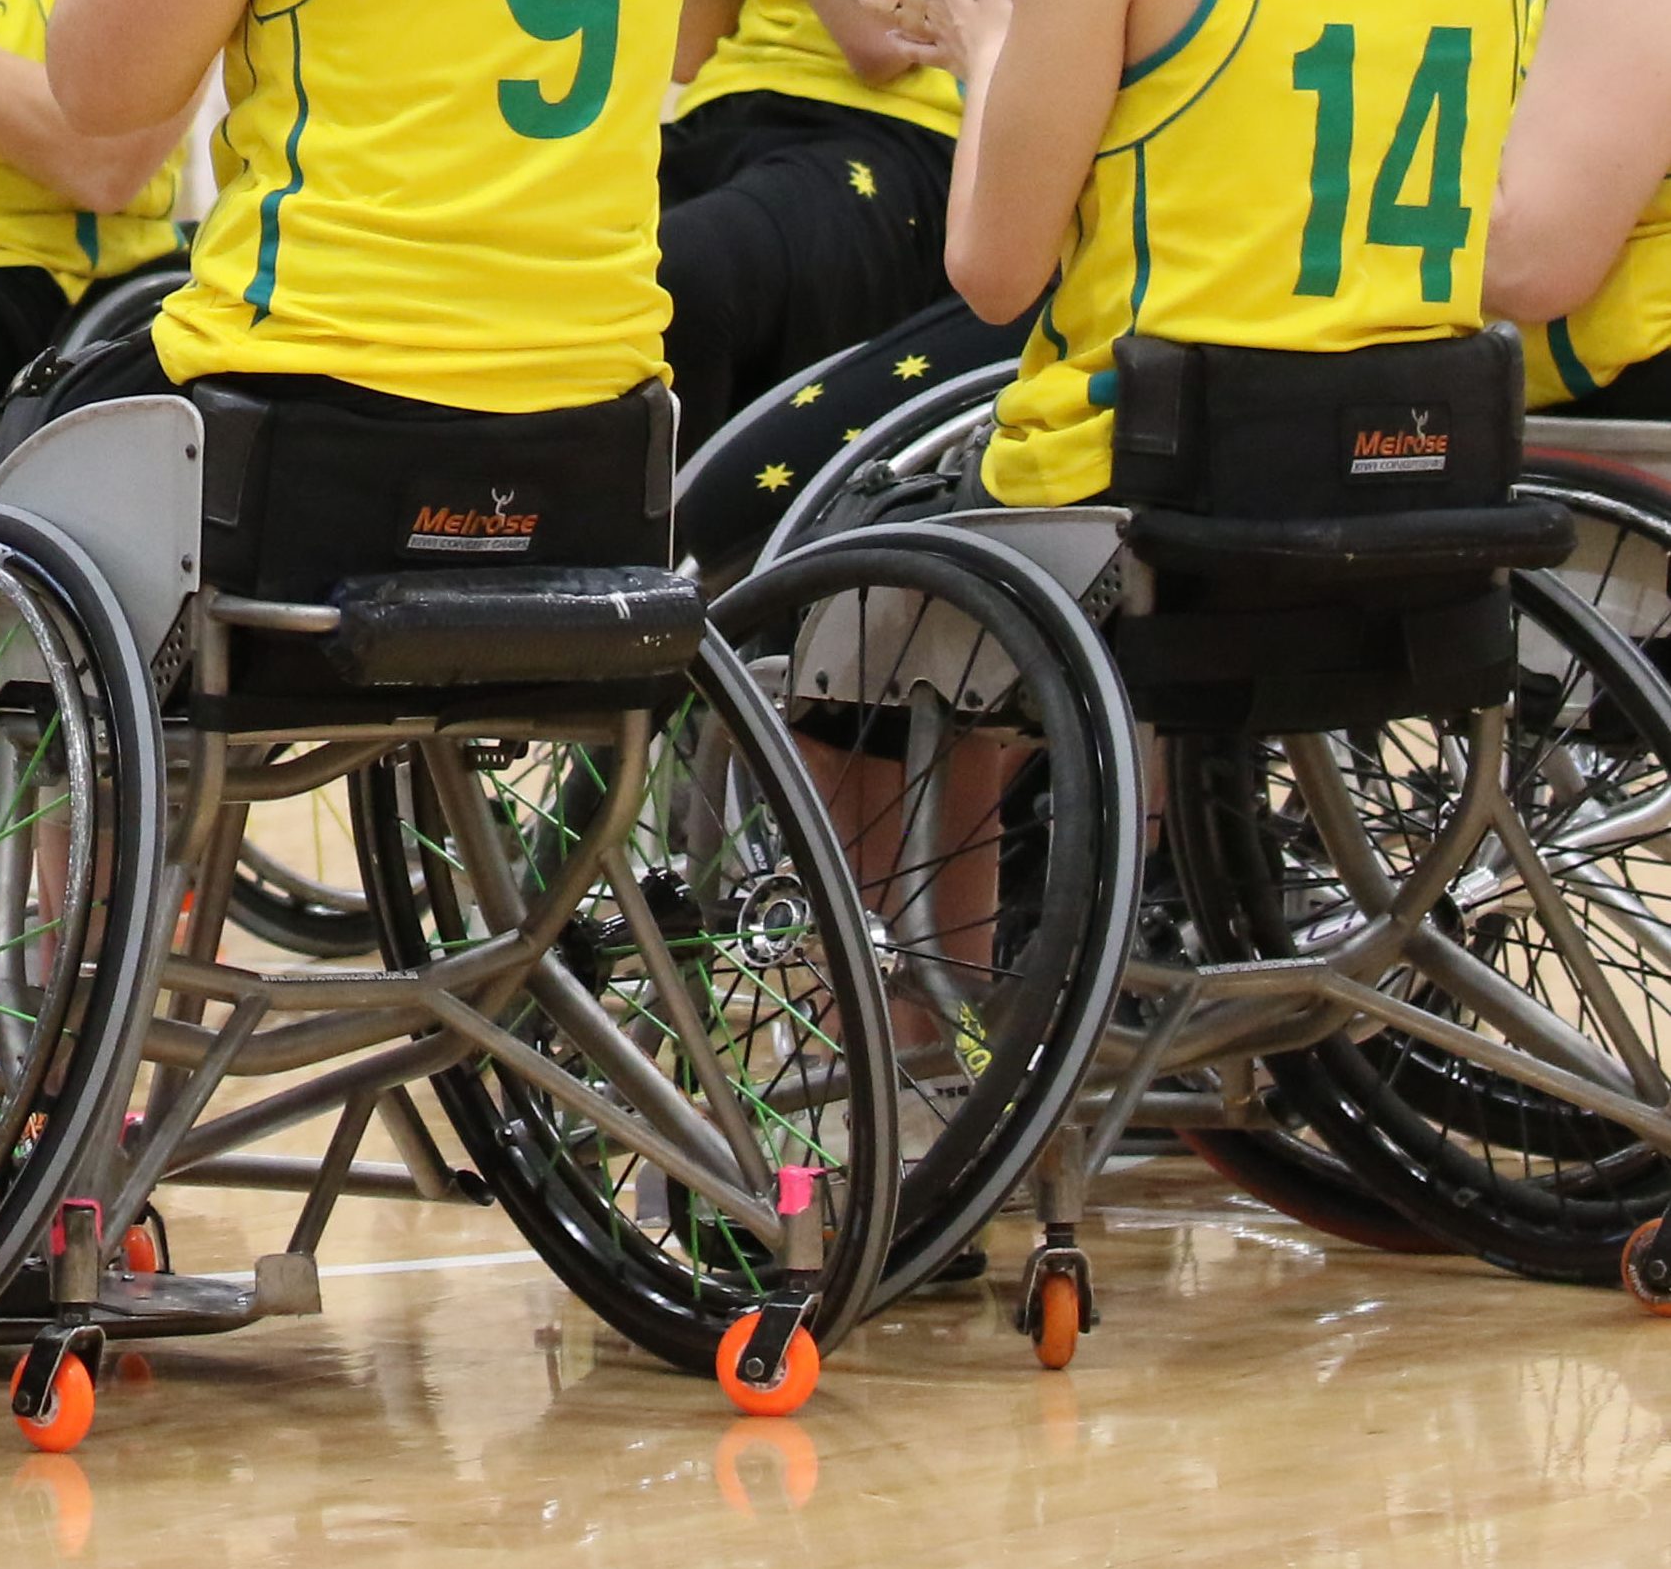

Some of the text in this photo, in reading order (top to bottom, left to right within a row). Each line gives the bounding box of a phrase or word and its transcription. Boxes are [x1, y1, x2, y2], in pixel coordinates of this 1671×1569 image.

[1292, 23, 1472, 303] 14
[1354, 431, 1449, 457] Melrose
[412, 506, 539, 536] Melrose
